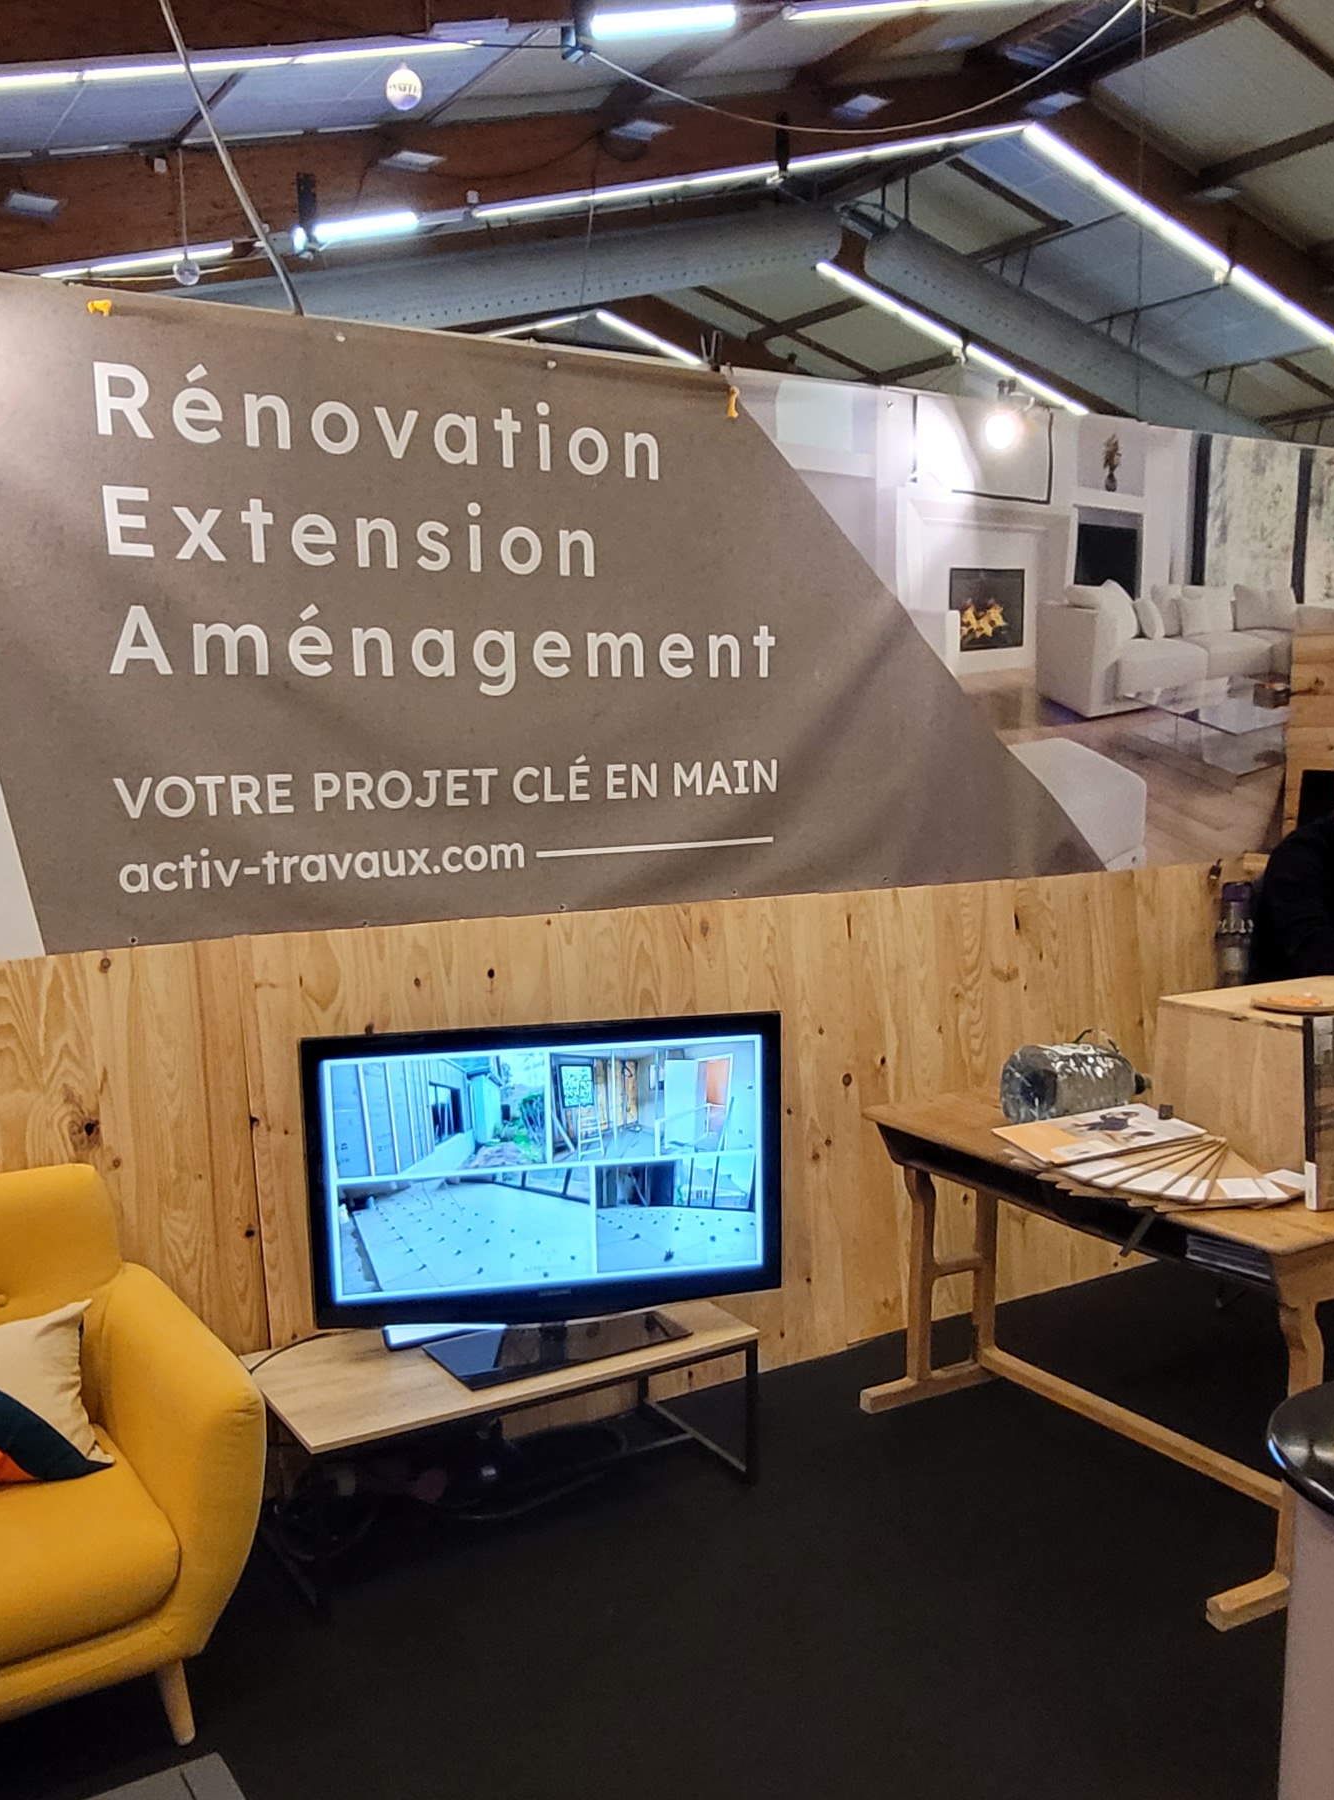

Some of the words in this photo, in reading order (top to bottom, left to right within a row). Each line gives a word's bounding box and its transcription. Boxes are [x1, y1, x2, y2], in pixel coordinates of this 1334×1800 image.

[91, 360, 662, 481] Rénovation
[101, 484, 598, 578] Extension
[109, 603, 777, 697] Aménagement
[113, 773, 294, 820] VOTRE
[313, 767, 499, 812] PROJET
[512, 755, 591, 805] CLÉ
[607, 763, 659, 800] EN
[672, 758, 779, 798] MAIN
[118, 840, 526, 894] activ-travaux.com
